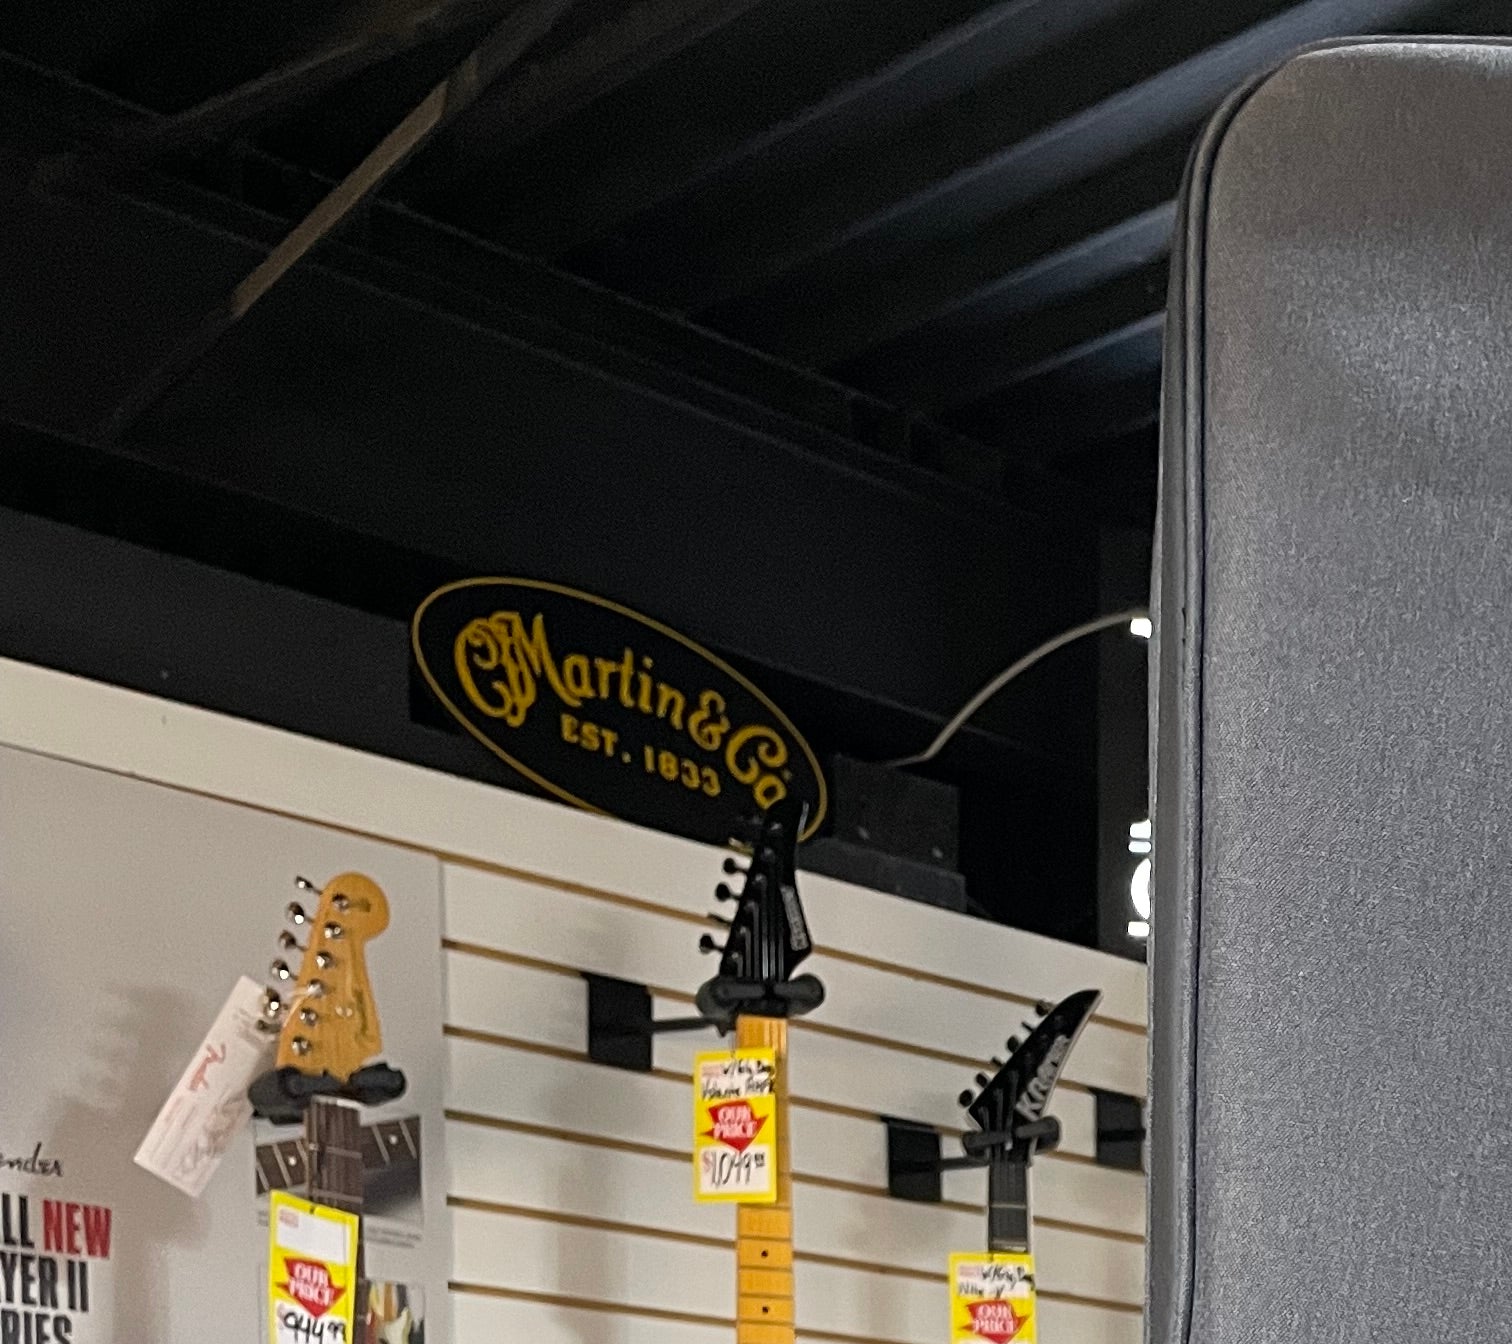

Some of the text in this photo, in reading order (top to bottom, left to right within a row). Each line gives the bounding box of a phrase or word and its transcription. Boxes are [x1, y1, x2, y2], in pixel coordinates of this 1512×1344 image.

[561, 713, 720, 797] EST. 1833
[718, 1105, 752, 1123] OUR
[713, 1121, 757, 1140] PRICE
[42, 1199, 112, 1259] NEW
[67, 1259, 89, 1313] II
[294, 1262, 329, 1287] OUR
[289, 1280, 335, 1307] PRICE
[977, 1304, 1012, 1320] OUR
[973, 1319, 1015, 1336] PRICE
